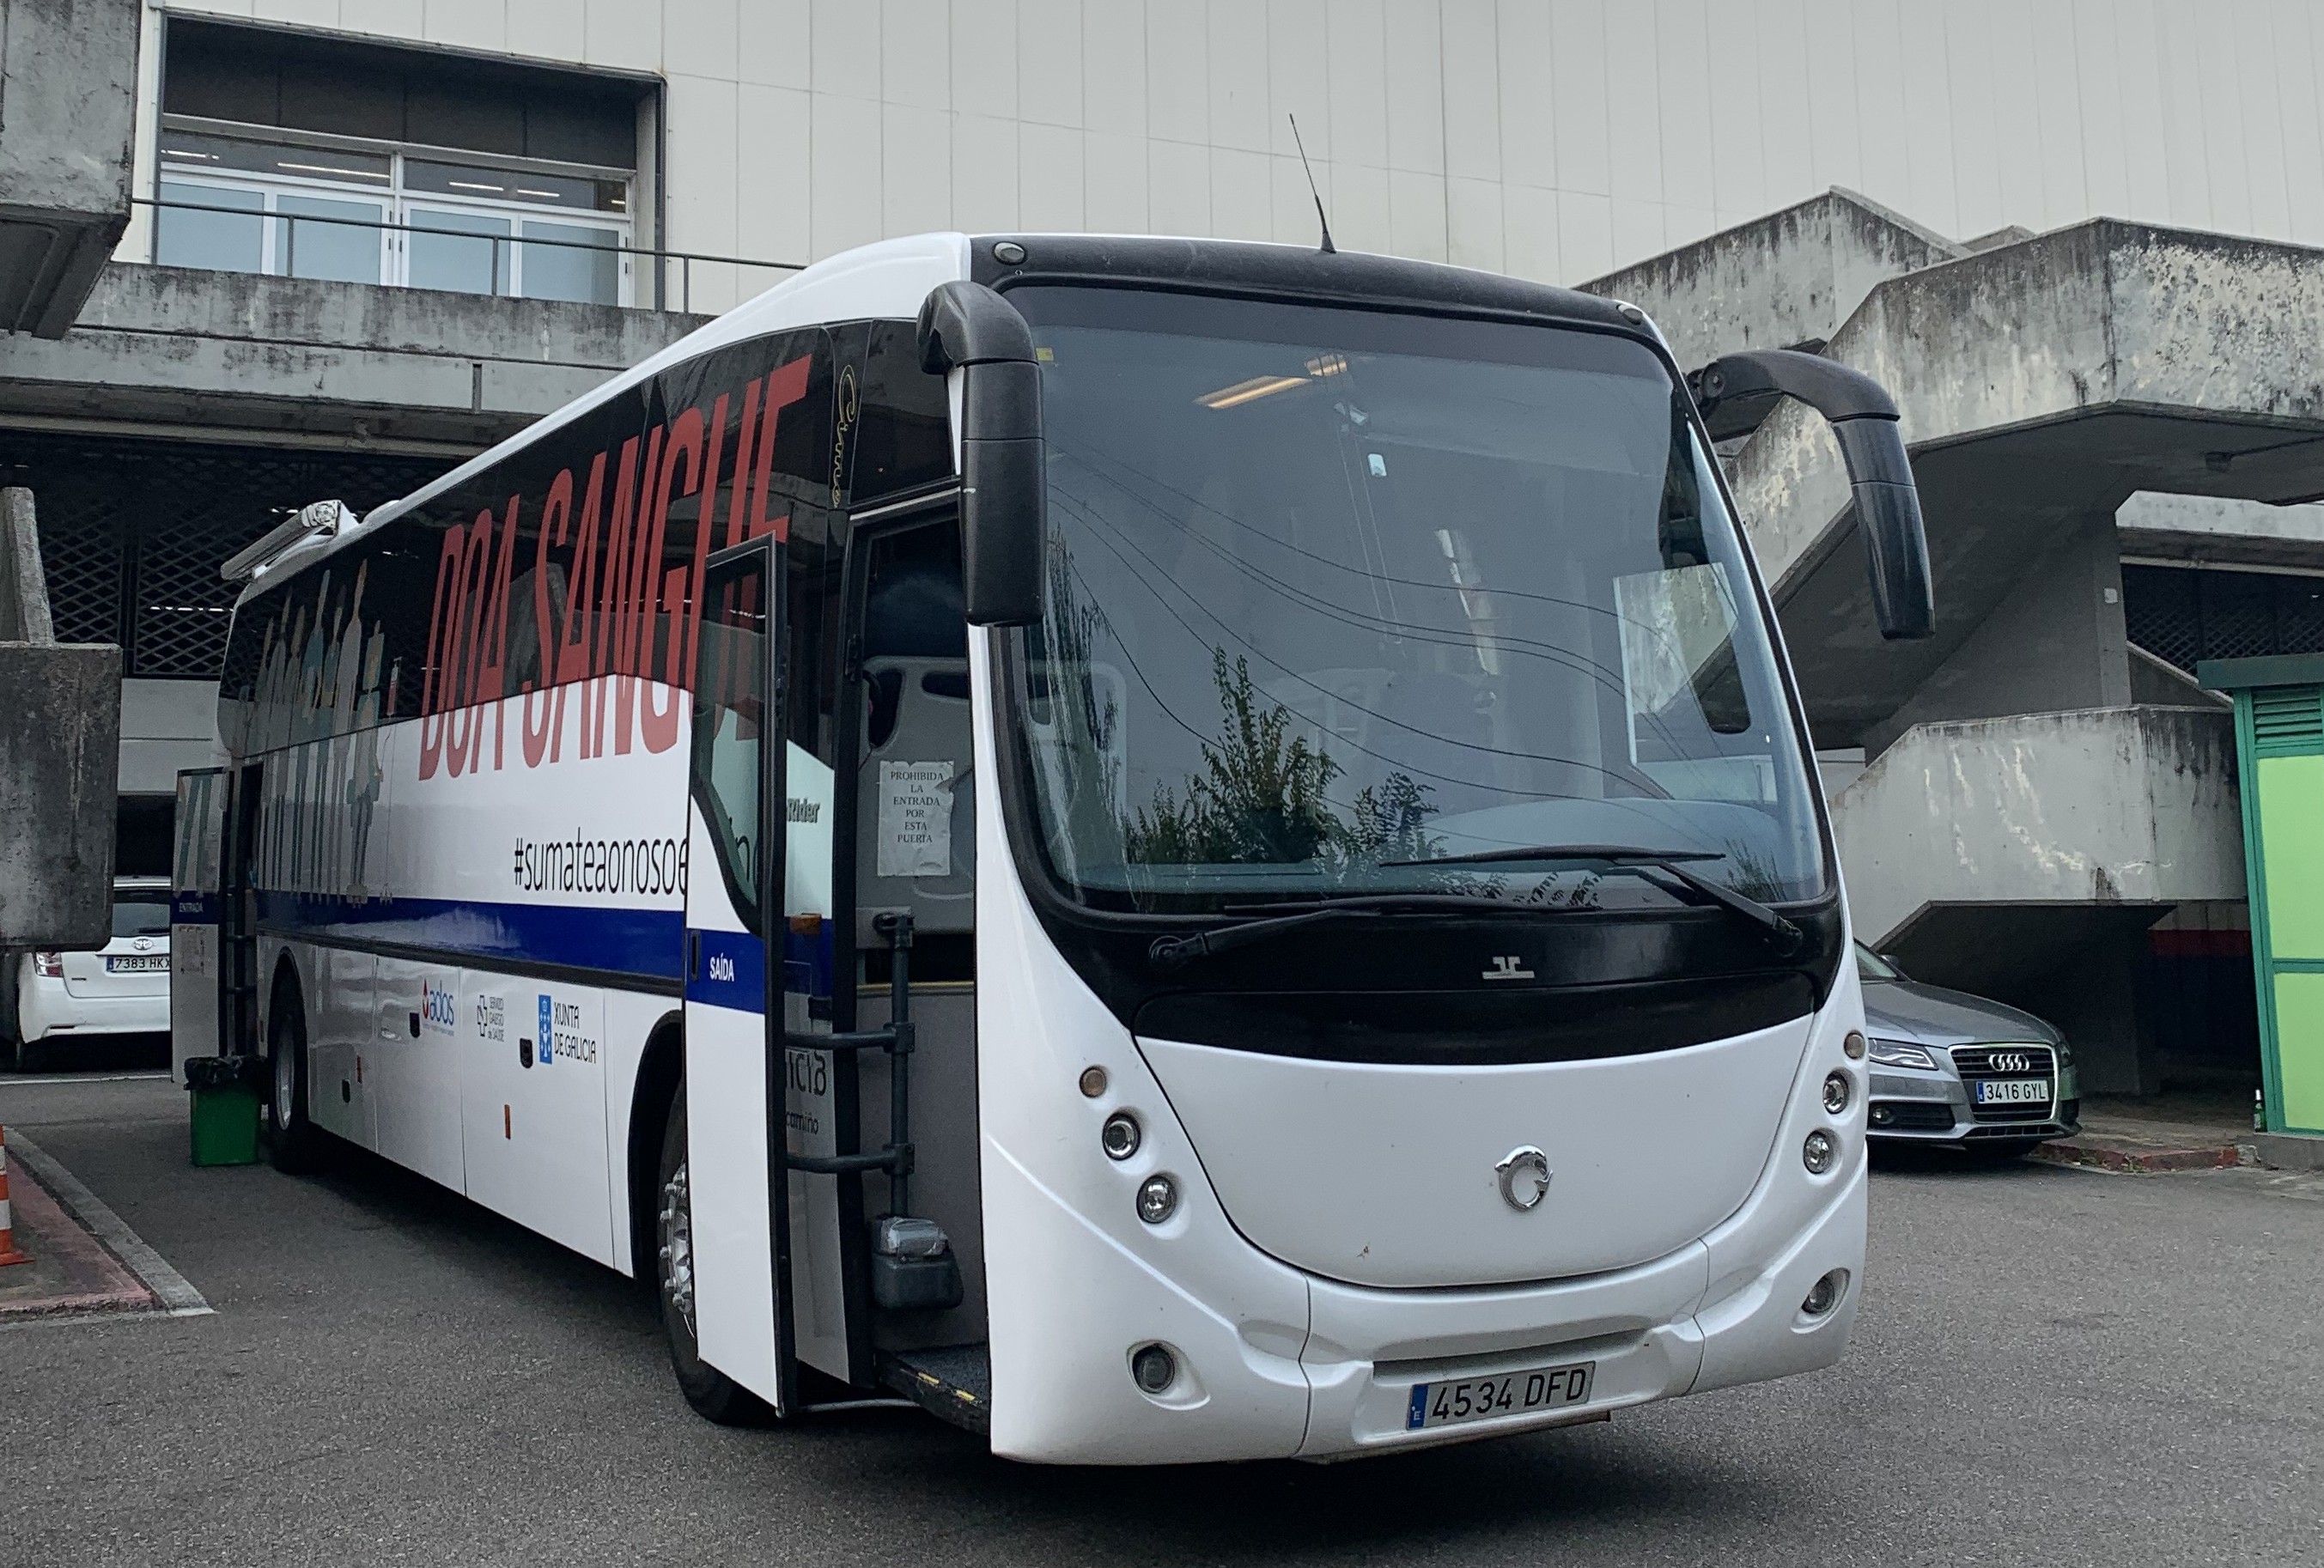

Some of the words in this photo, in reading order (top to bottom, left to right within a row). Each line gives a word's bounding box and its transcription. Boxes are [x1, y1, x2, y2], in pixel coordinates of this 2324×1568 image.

[418, 494, 520, 781] DOA
[891, 771, 944, 781] PROHIBIDA
[910, 784, 924, 793] LA
[786, 797, 821, 824] Rider
[893, 797, 940, 806] ENTRADA
[905, 809, 925, 818] POR
[904, 821, 928, 831] ESTA
[897, 834, 934, 843] PUERTA
[514, 826, 689, 896] #sumateaonosoe
[115, 958, 146, 969] 7383
[149, 958, 170, 969] HKX
[709, 952, 735, 982] SAÍDA
[554, 1001, 580, 1029] XUNTA
[554, 1032, 564, 1056] DE
[565, 1035, 596, 1064] GALICIA
[1986, 1083, 2020, 1101] 3416
[2023, 1083, 2046, 1099] GYL
[1431, 1377, 1513, 1419] 4534
[1524, 1368, 1586, 1407] DFD
